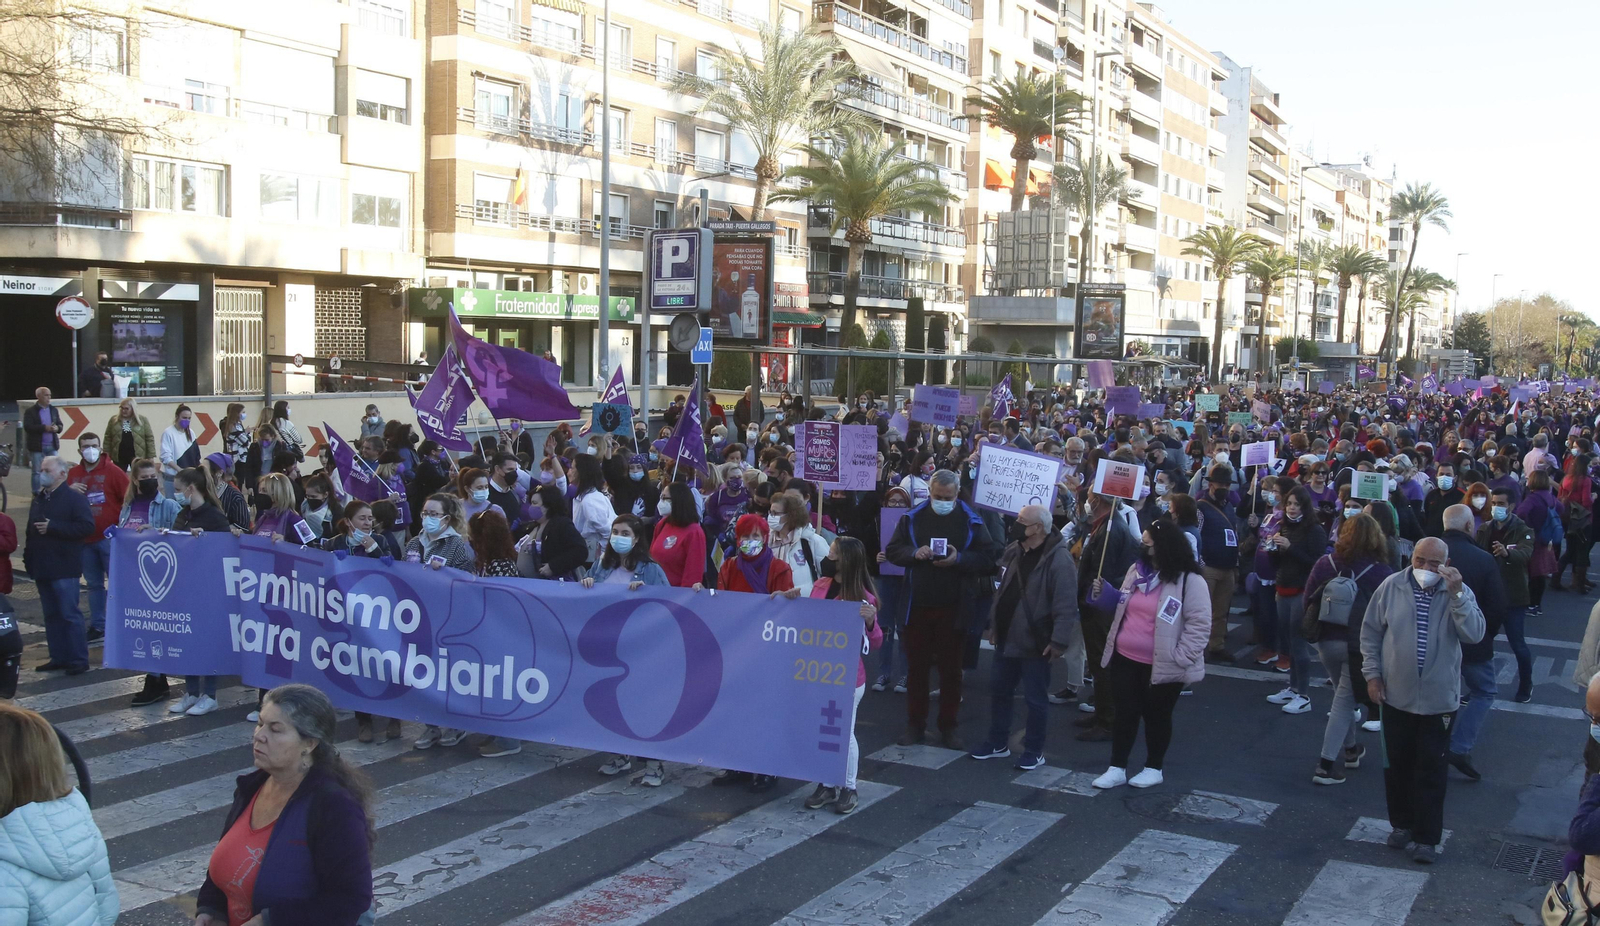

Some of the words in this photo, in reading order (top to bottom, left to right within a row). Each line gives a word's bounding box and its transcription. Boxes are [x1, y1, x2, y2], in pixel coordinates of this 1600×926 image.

[662, 238, 689, 278] P
[3, 280, 36, 291] Neinor
[288, 294, 296, 302] 21
[495, 294, 560, 314] Fraternidad
[666, 296, 684, 305] LIBRE
[622, 337, 629, 346] 23
[1000, 457, 1013, 466] HAY
[1013, 479, 1050, 497] RESISTA
[985, 490, 1012, 509] #8M
[222, 557, 421, 634] Feminismo
[124, 608, 151, 618] UNIDAS
[152, 611, 191, 622] PODEMOS
[124, 619, 141, 629] POR
[142, 622, 192, 634] ANDALUCÍA
[762, 620, 848, 649] 8marzo
[310, 636, 549, 704] cambiarlo
[794, 659, 846, 686] 2022
